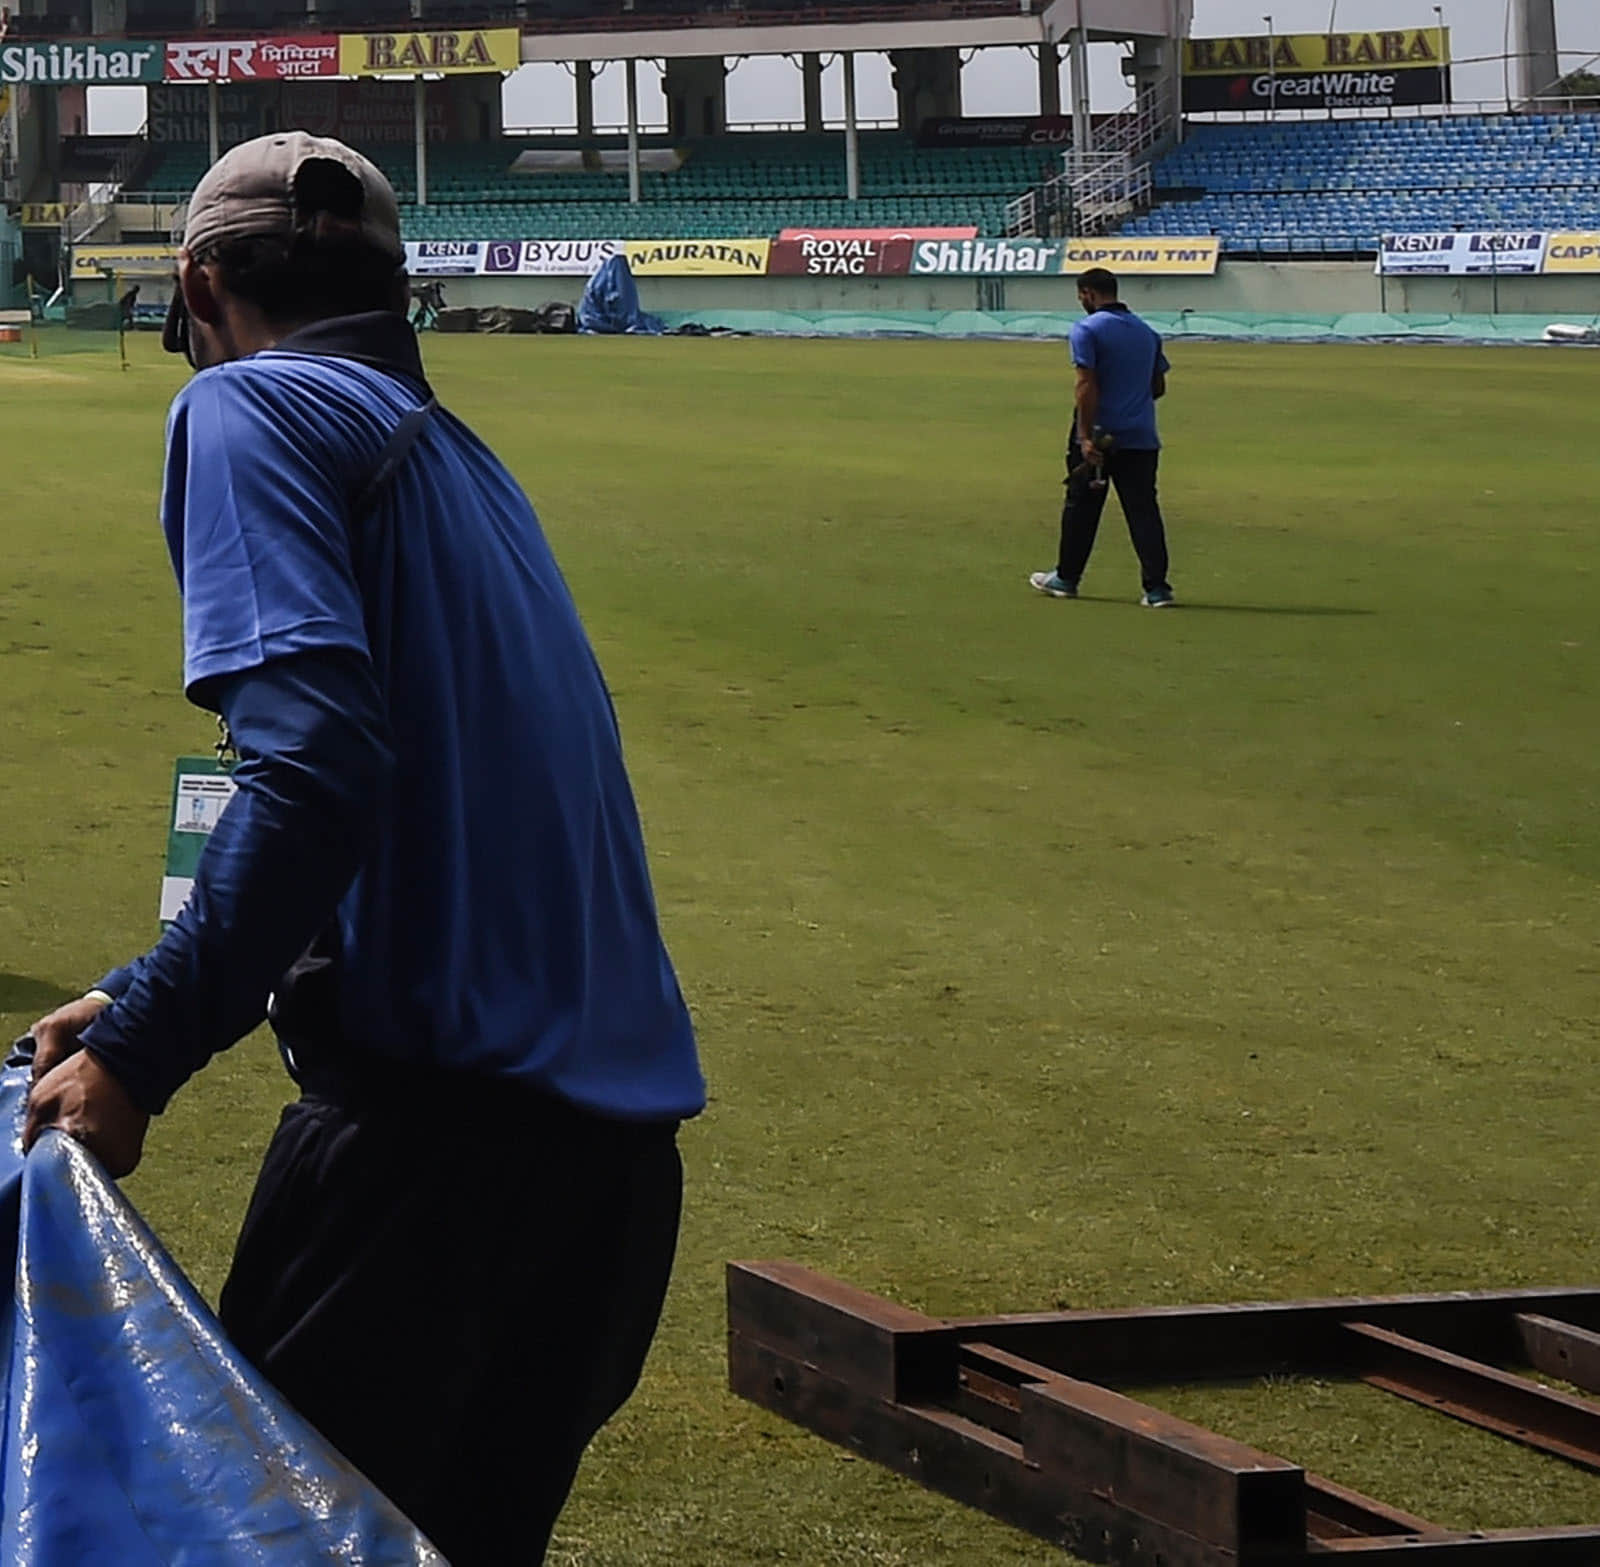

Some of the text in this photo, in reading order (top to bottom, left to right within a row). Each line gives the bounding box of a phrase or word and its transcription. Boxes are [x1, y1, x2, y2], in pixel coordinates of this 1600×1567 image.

[363, 32, 496, 70] BABA
[1190, 38, 1300, 69] BABA
[1323, 31, 1437, 65] BABA
[0, 45, 150, 82] Shikhar
[1252, 73, 1395, 97] GreatWhite
[425, 242, 469, 256] KENT
[524, 242, 615, 262] BYJU'S
[801, 240, 876, 257] ROYAL
[1393, 235, 1446, 251] KENT
[631, 243, 763, 270] NAURATAN
[807, 257, 865, 275] STAG
[915, 241, 1056, 273] Shikhar
[1067, 249, 1212, 262] CAPTAIN TMT
